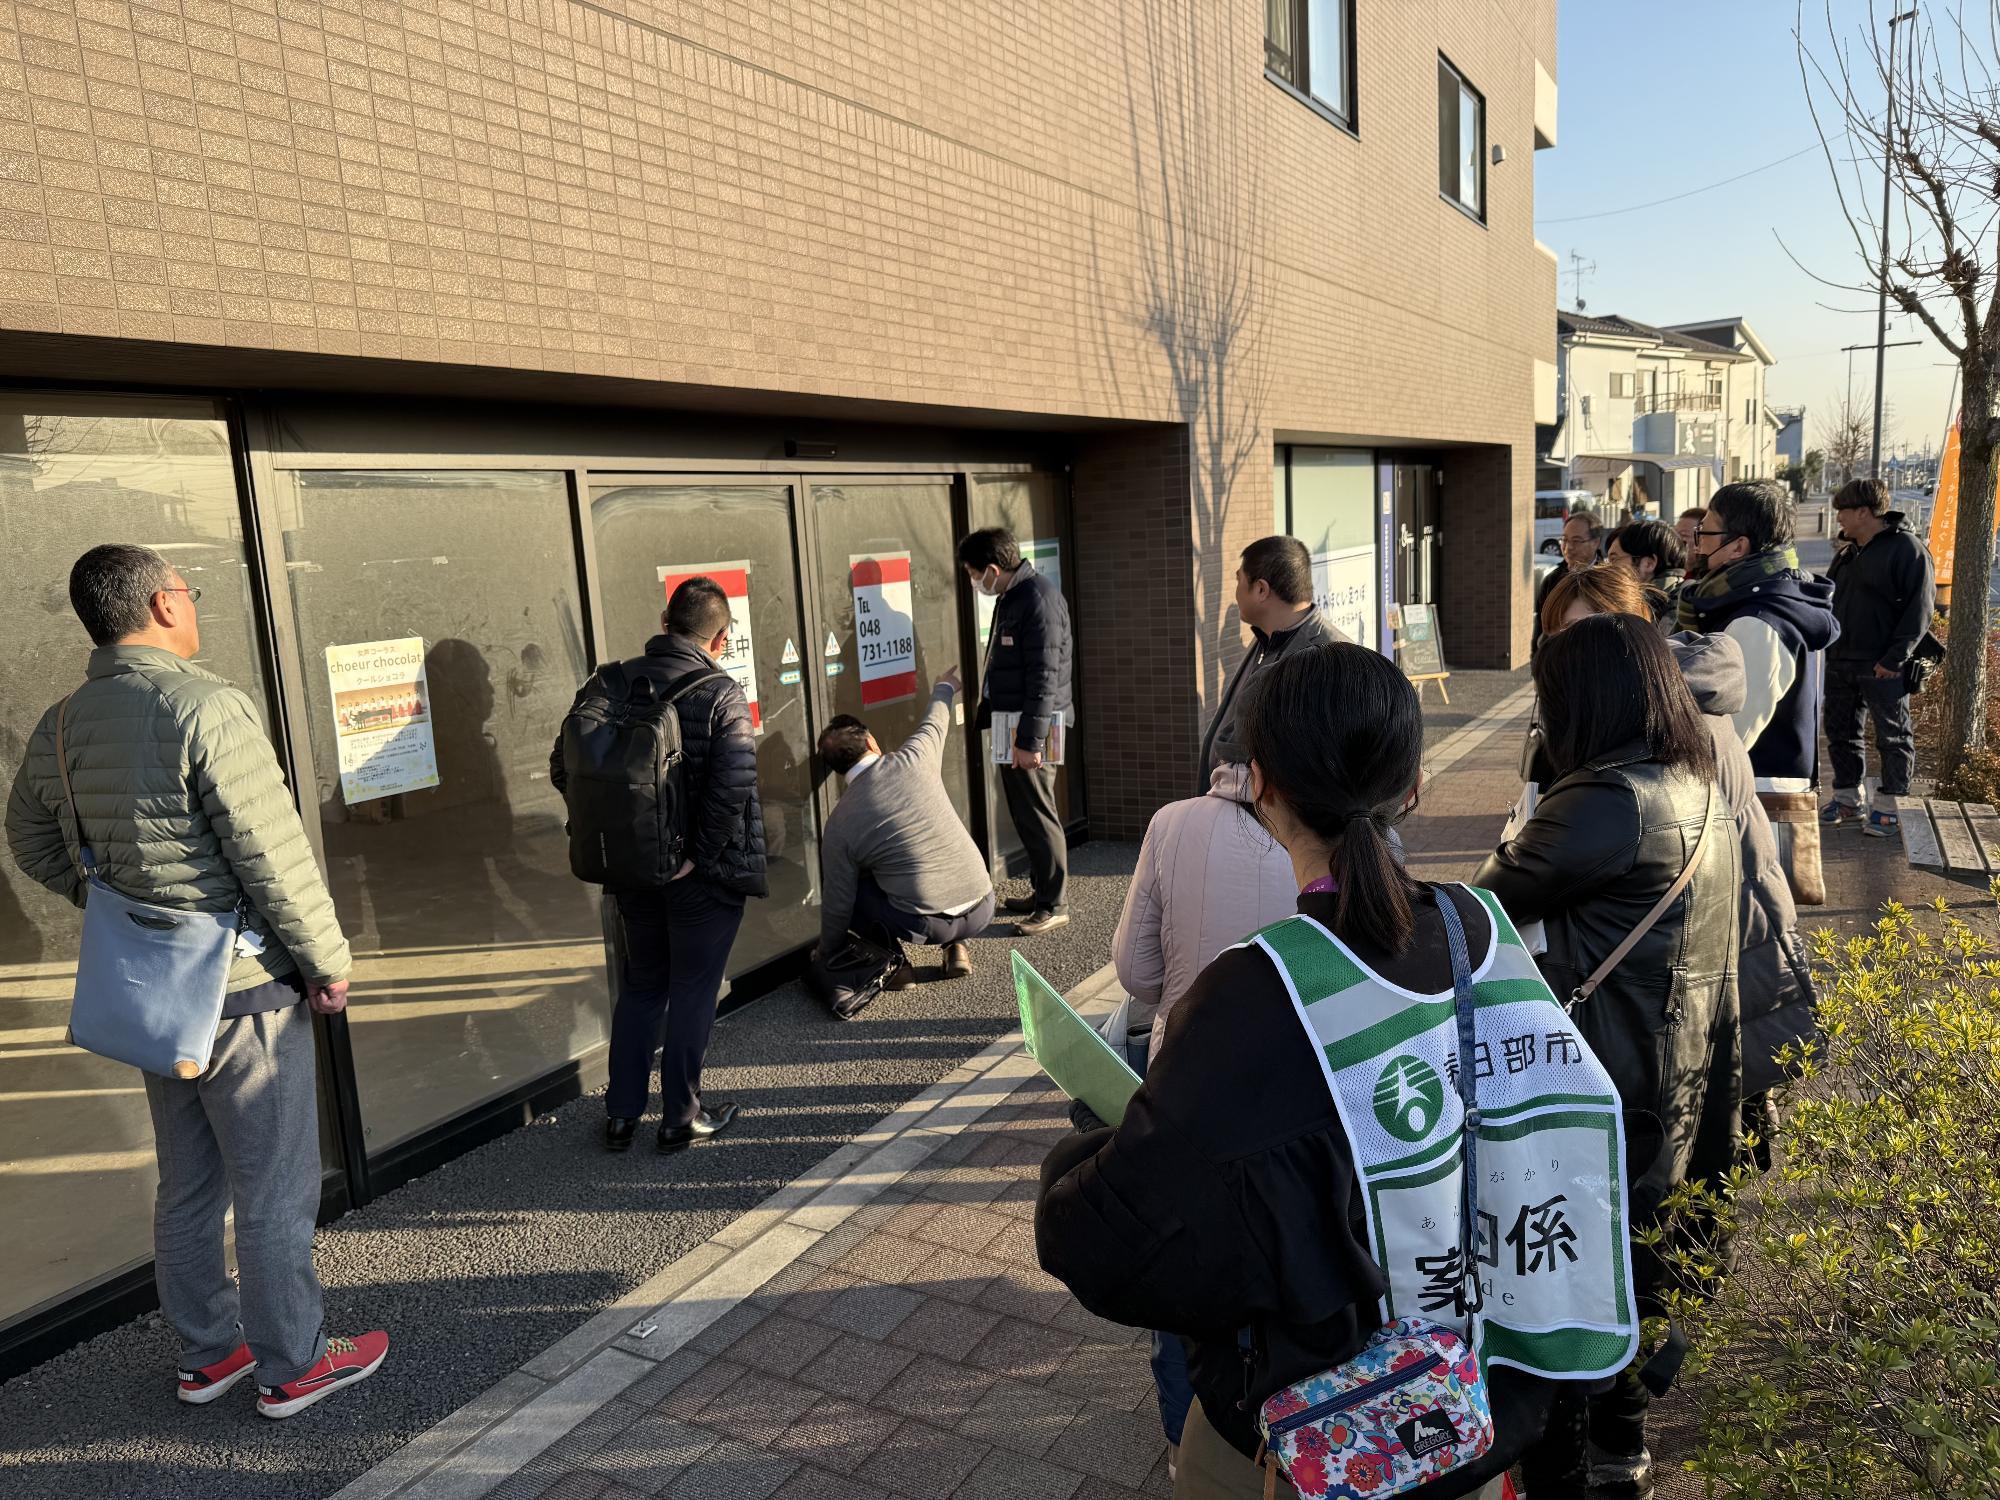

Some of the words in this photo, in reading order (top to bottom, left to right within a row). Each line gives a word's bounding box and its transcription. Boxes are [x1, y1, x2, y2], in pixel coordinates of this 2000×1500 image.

[860, 618, 881, 637] 048
[862, 637, 912, 662] 731-1188
[330, 659, 370, 674] choeur
[373, 652, 422, 668] chocolat
[356, 671, 406, 685] クールショコラ
[1413, 1430, 1450, 1453] GREGORY
